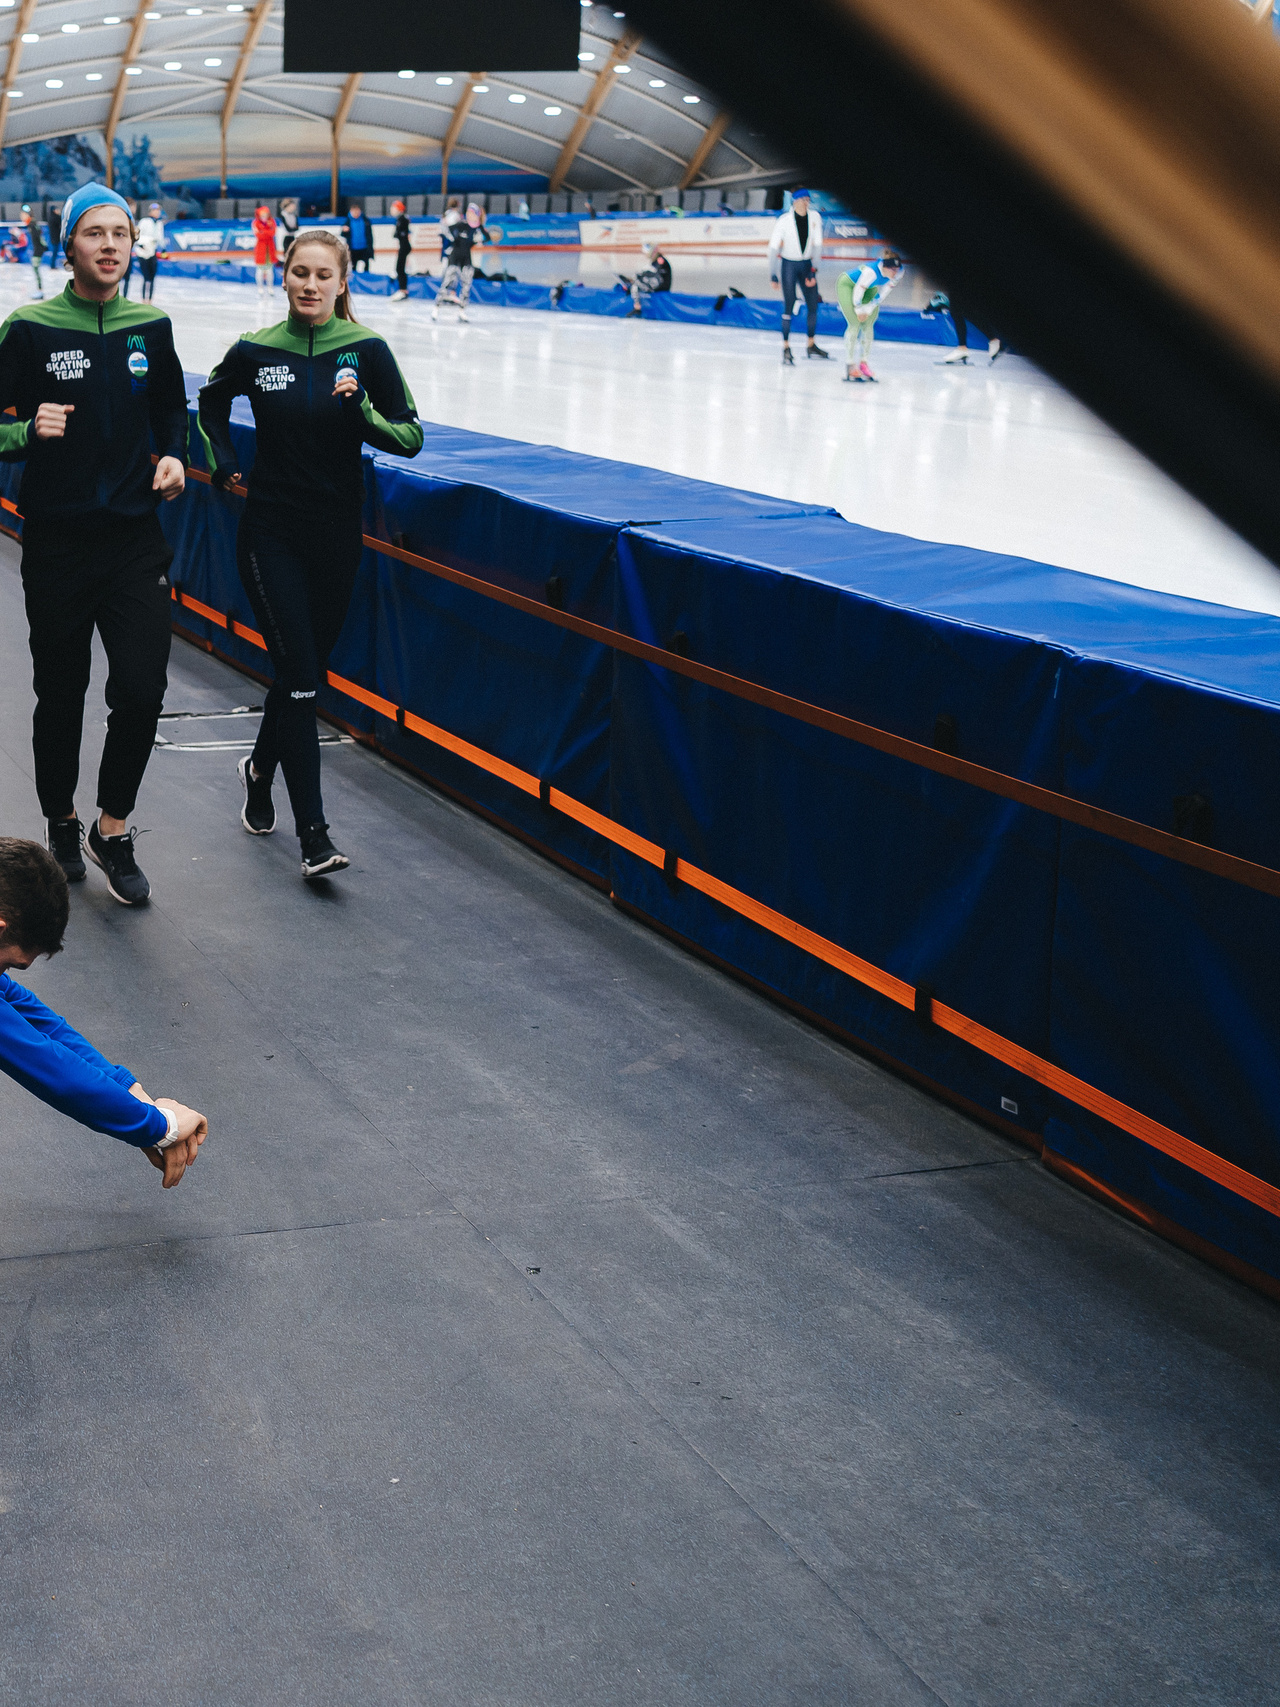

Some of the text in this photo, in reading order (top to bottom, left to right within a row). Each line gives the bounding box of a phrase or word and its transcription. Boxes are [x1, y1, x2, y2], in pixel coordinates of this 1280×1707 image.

[50, 350, 84, 362] SPEED
[46, 358, 91, 372] SKATING
[258, 365, 289, 376] SPEED
[55, 369, 84, 380] TEAM
[255, 374, 296, 385] SKATING
[260, 382, 287, 392] TEAM
